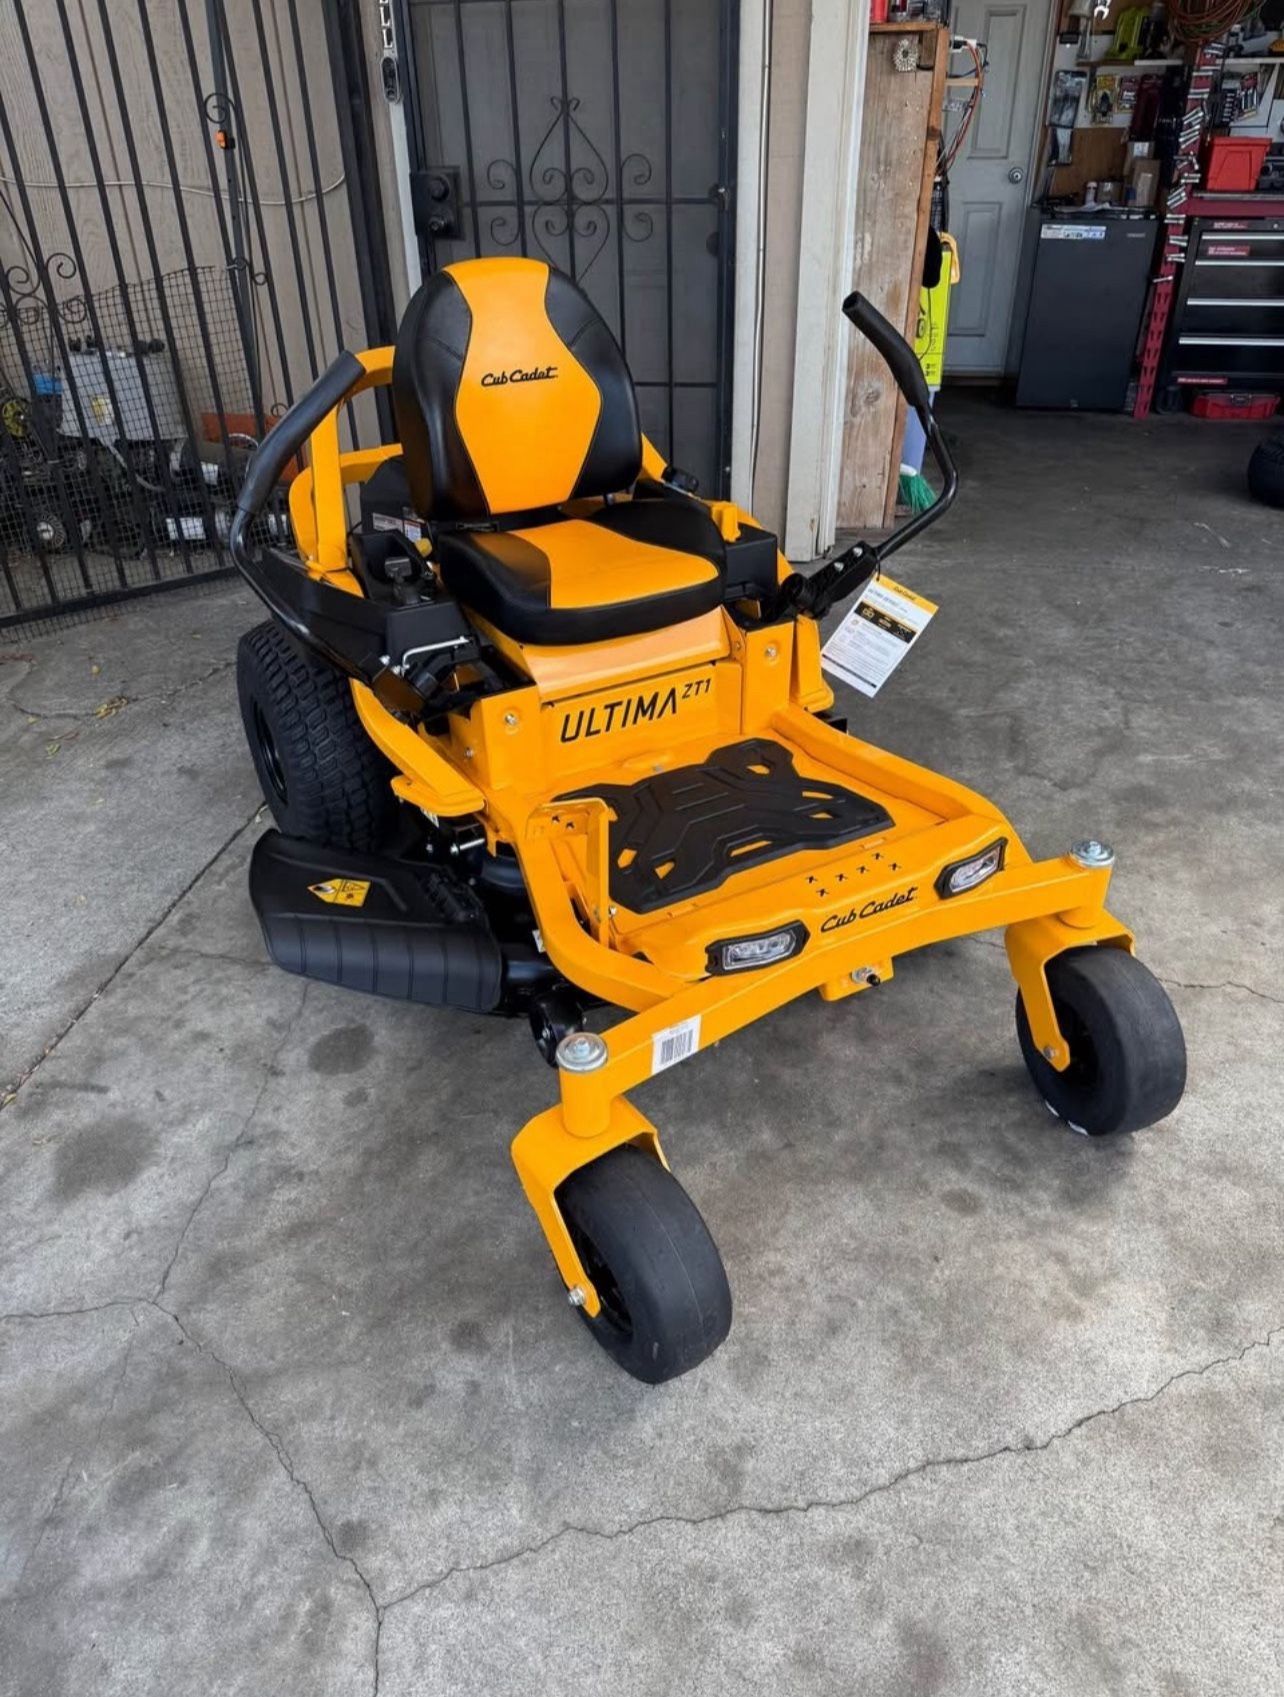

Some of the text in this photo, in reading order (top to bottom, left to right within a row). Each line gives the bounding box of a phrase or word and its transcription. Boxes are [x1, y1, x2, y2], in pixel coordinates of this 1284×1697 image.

[481, 366, 558, 387] Cub Cadet
[560, 678, 711, 743] ULTIMA ZT1
[820, 886, 918, 933] Cub Cadet
